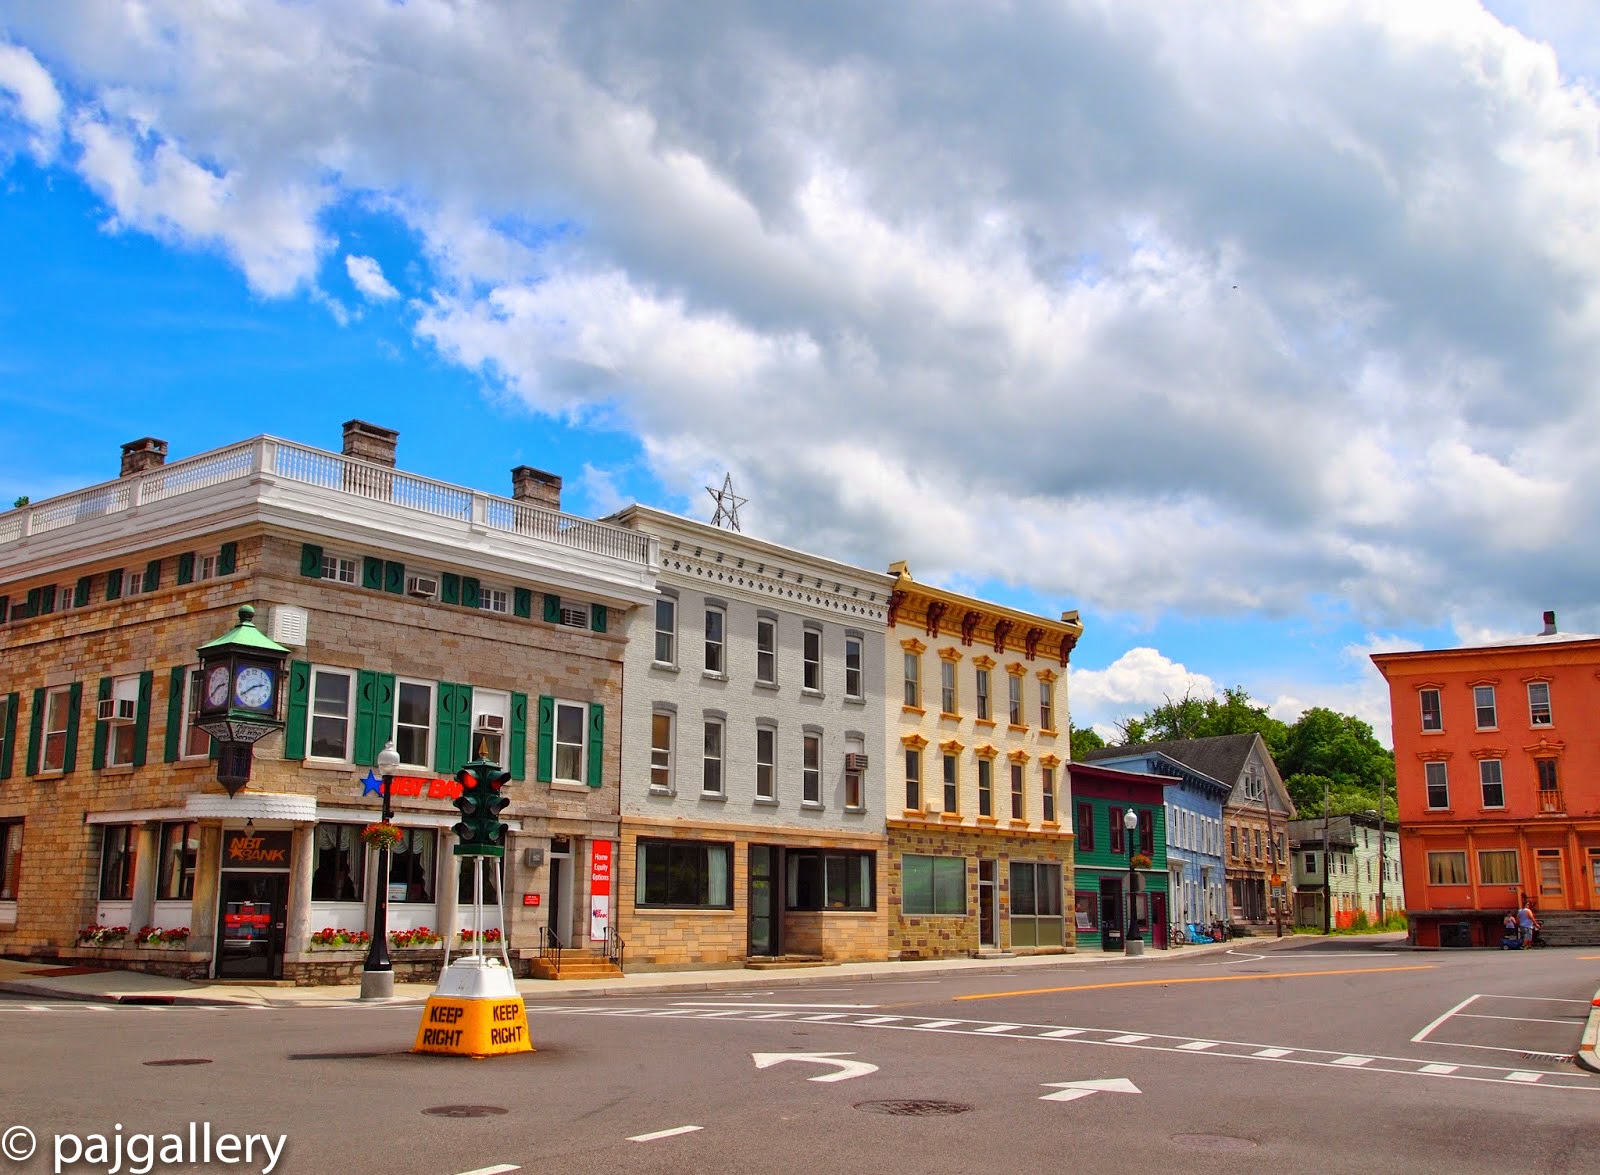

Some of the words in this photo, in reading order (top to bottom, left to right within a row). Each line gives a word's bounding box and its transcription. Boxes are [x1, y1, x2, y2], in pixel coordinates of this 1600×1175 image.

[230, 837, 266, 849] NBT
[242, 849, 286, 861] BANK
[593, 863, 608, 872] Equity
[592, 873, 609, 881] Options
[430, 1006, 463, 1024] KEEP
[493, 1004, 519, 1021] KEEP
[423, 1028, 463, 1046] RIGHT
[491, 1025, 522, 1045] RIGHT
